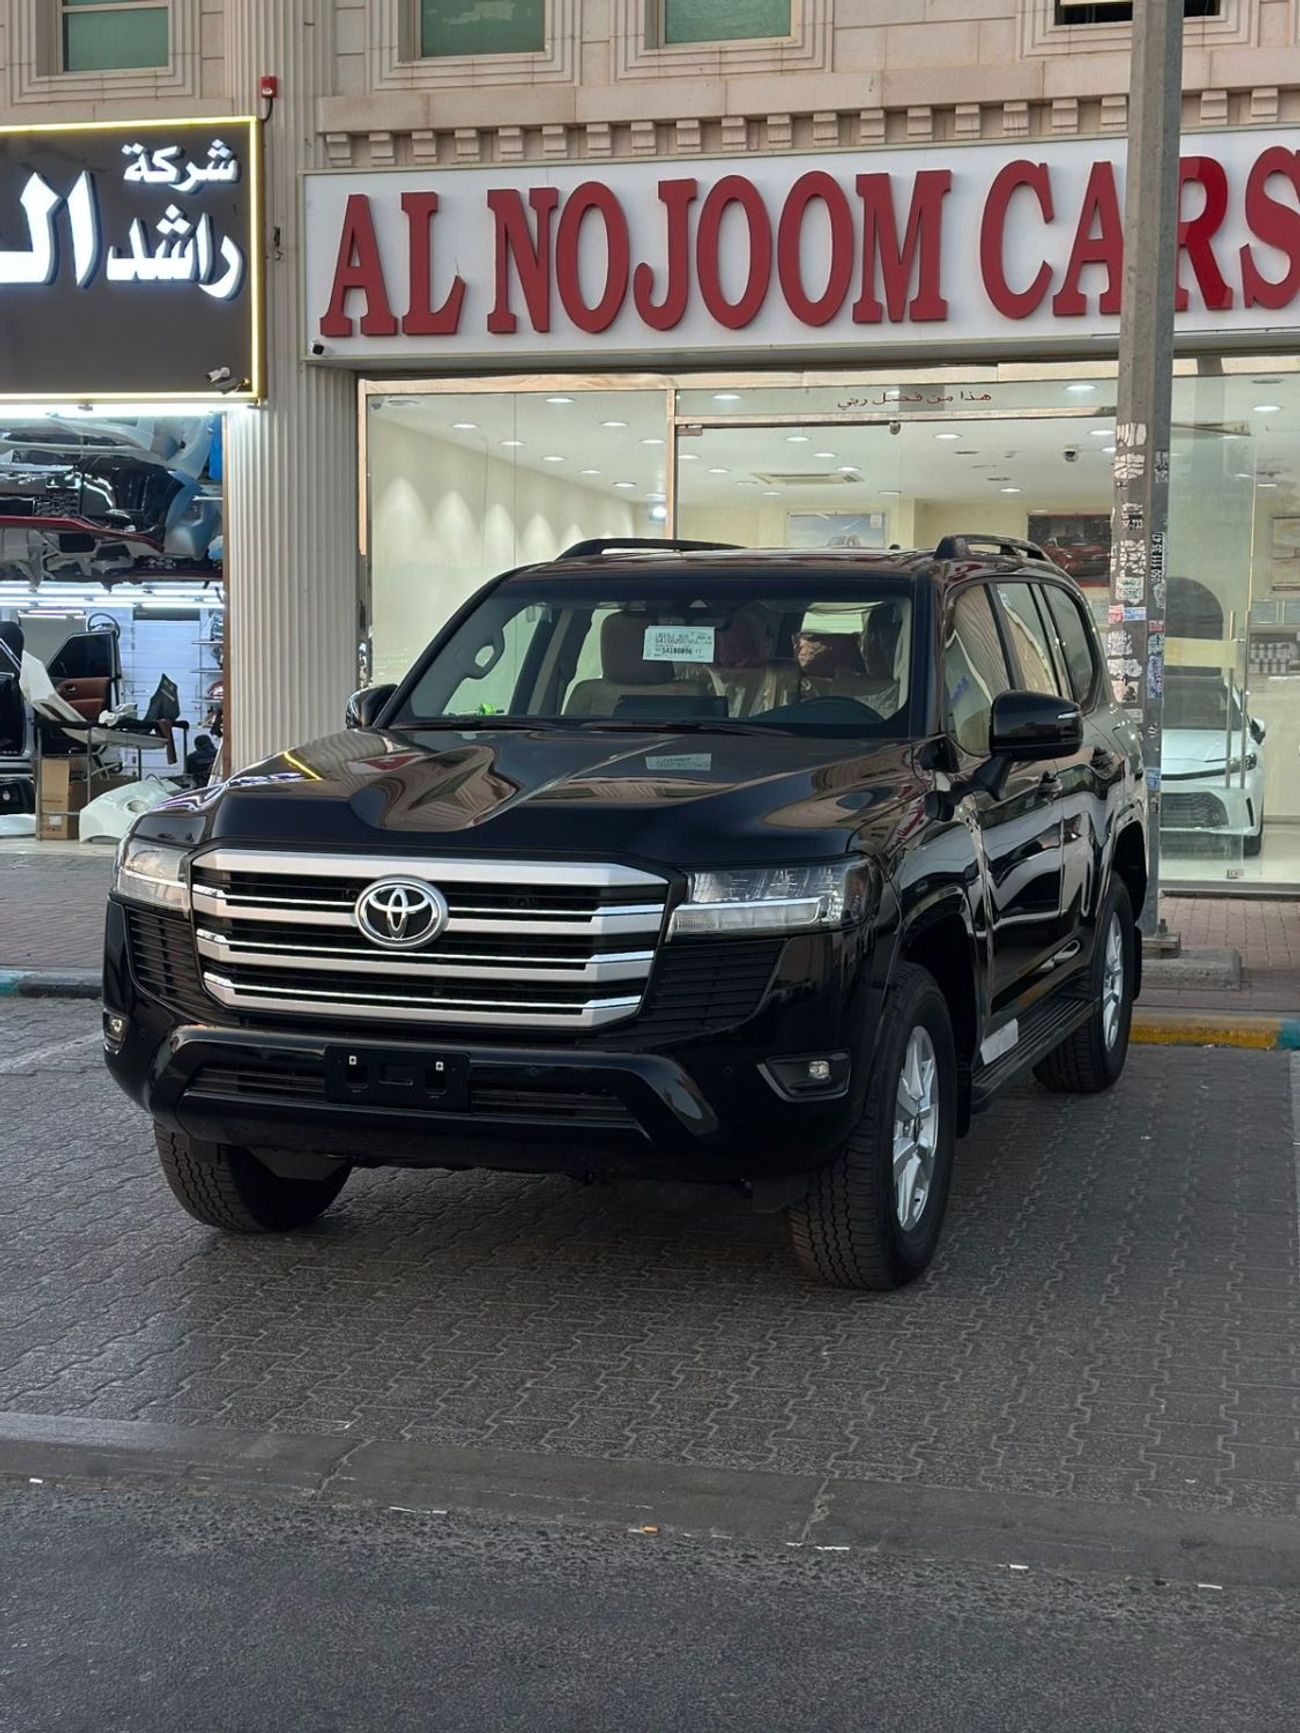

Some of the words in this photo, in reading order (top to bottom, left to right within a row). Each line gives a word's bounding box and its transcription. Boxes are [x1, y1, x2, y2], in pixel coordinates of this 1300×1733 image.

[121, 139, 239, 193] شركة
[319, 191, 466, 337] AL
[487, 169, 952, 334] NOJOOM
[980, 145, 1300, 320] CARS
[106, 203, 243, 299] راشد
[872, 391, 923, 405] فضل
[926, 394, 954, 404] من
[960, 390, 992, 401] هذا
[837, 398, 868, 410] ربي
